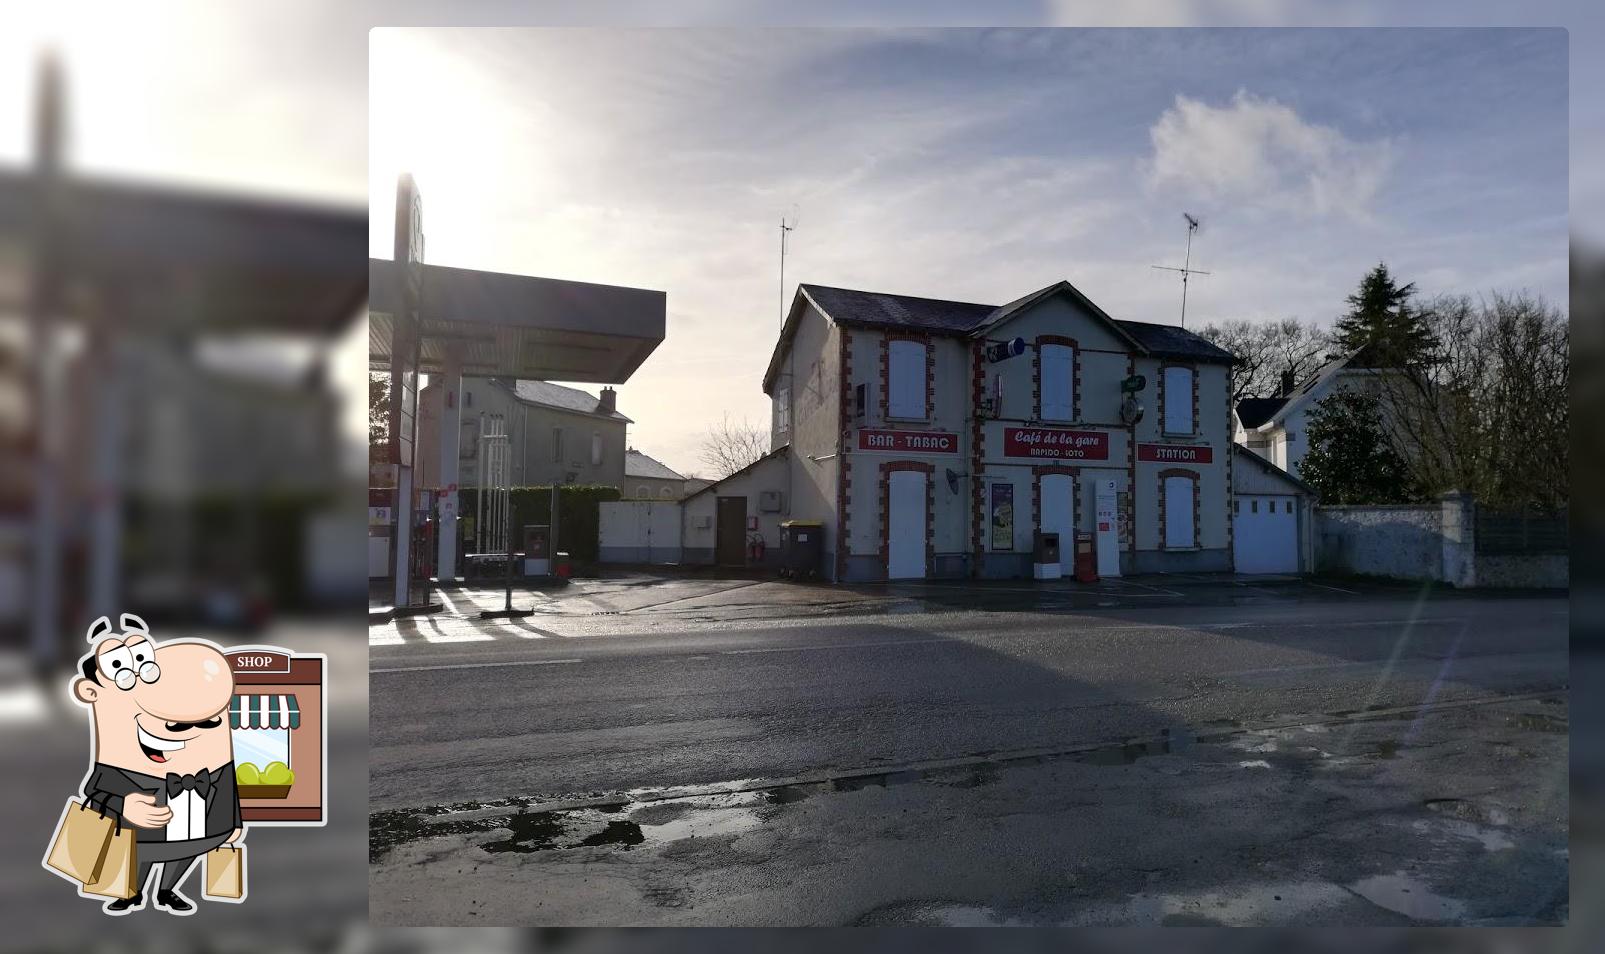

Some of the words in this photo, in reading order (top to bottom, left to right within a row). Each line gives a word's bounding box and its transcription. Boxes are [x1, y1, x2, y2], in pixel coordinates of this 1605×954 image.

[867, 434, 894, 447] BAR
[904, 436, 950, 449] TABAC
[1014, 430, 1042, 445] Café
[1043, 432, 1058, 444] de
[1059, 432, 1073, 444] la
[1075, 436, 1100, 448] gare
[1030, 447, 1060, 457] RAPIDO
[1065, 449, 1085, 458] LOTO
[1156, 448, 1196, 460] STATION
